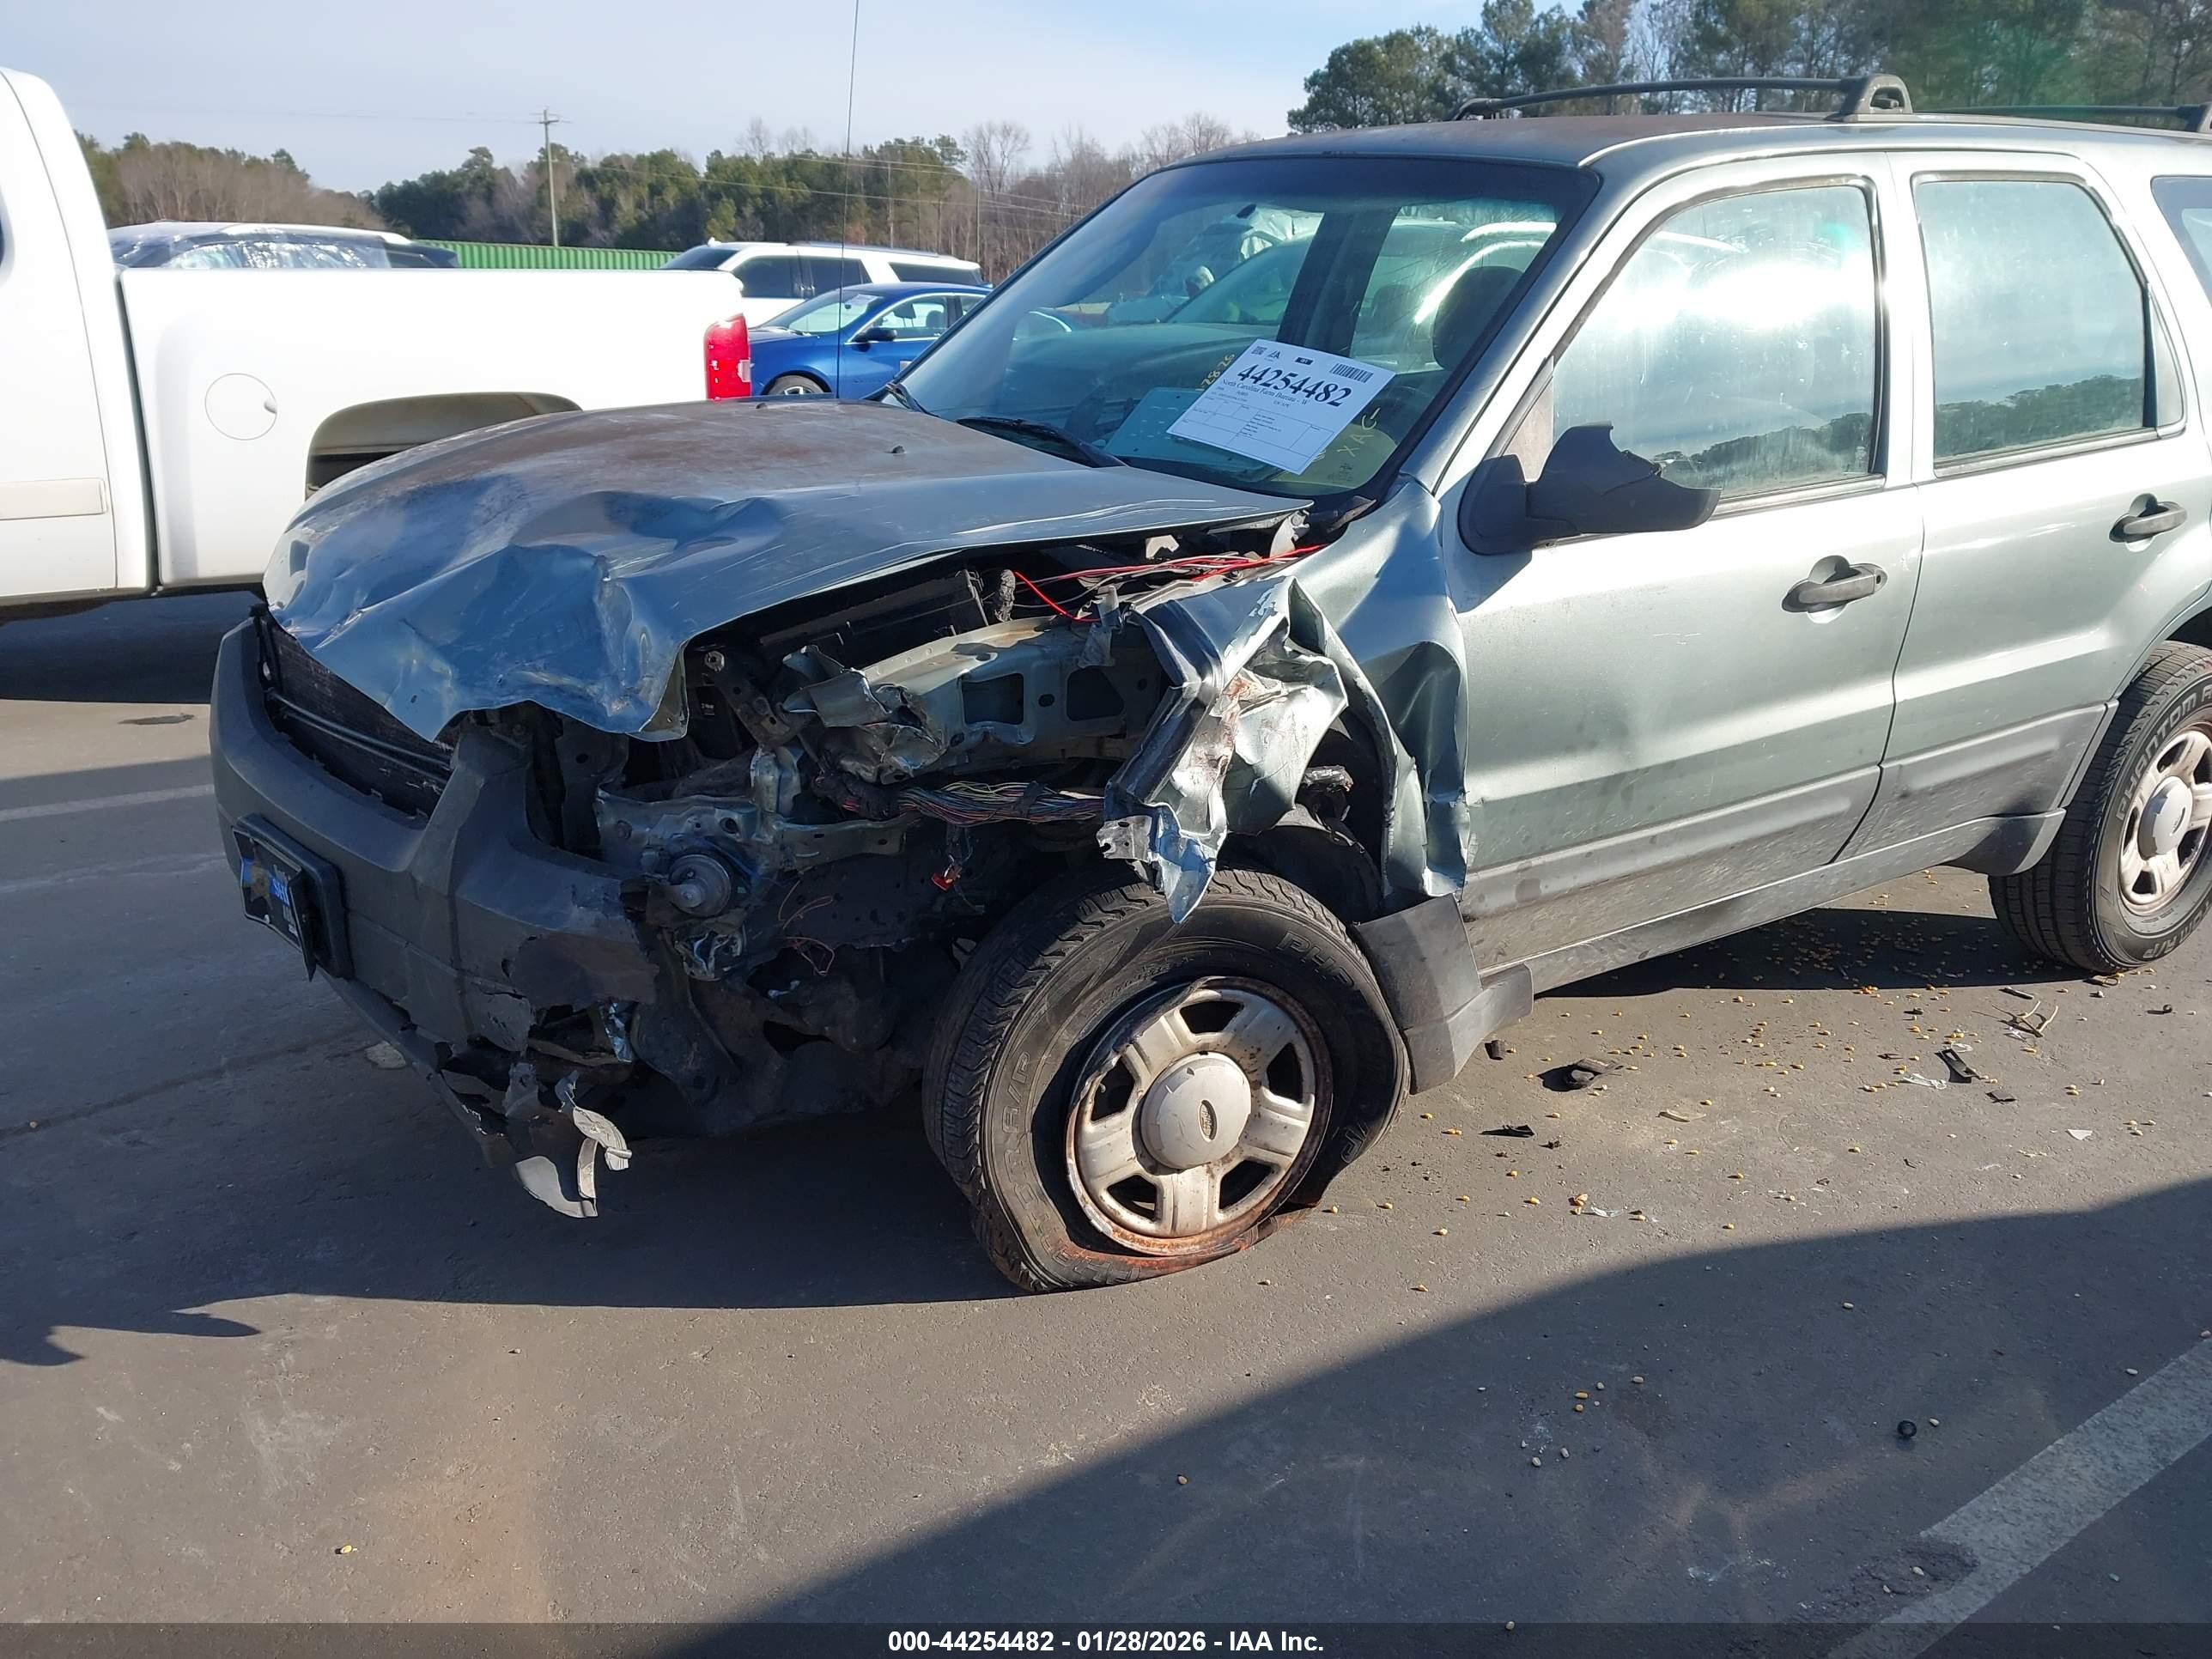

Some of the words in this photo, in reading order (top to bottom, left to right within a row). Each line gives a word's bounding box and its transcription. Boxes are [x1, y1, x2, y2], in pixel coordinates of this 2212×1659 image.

[1237, 364, 1352, 407] 44254482
[2115, 692, 2197, 821] PHANTOM
[1001, 1051, 1031, 1134] A/P
